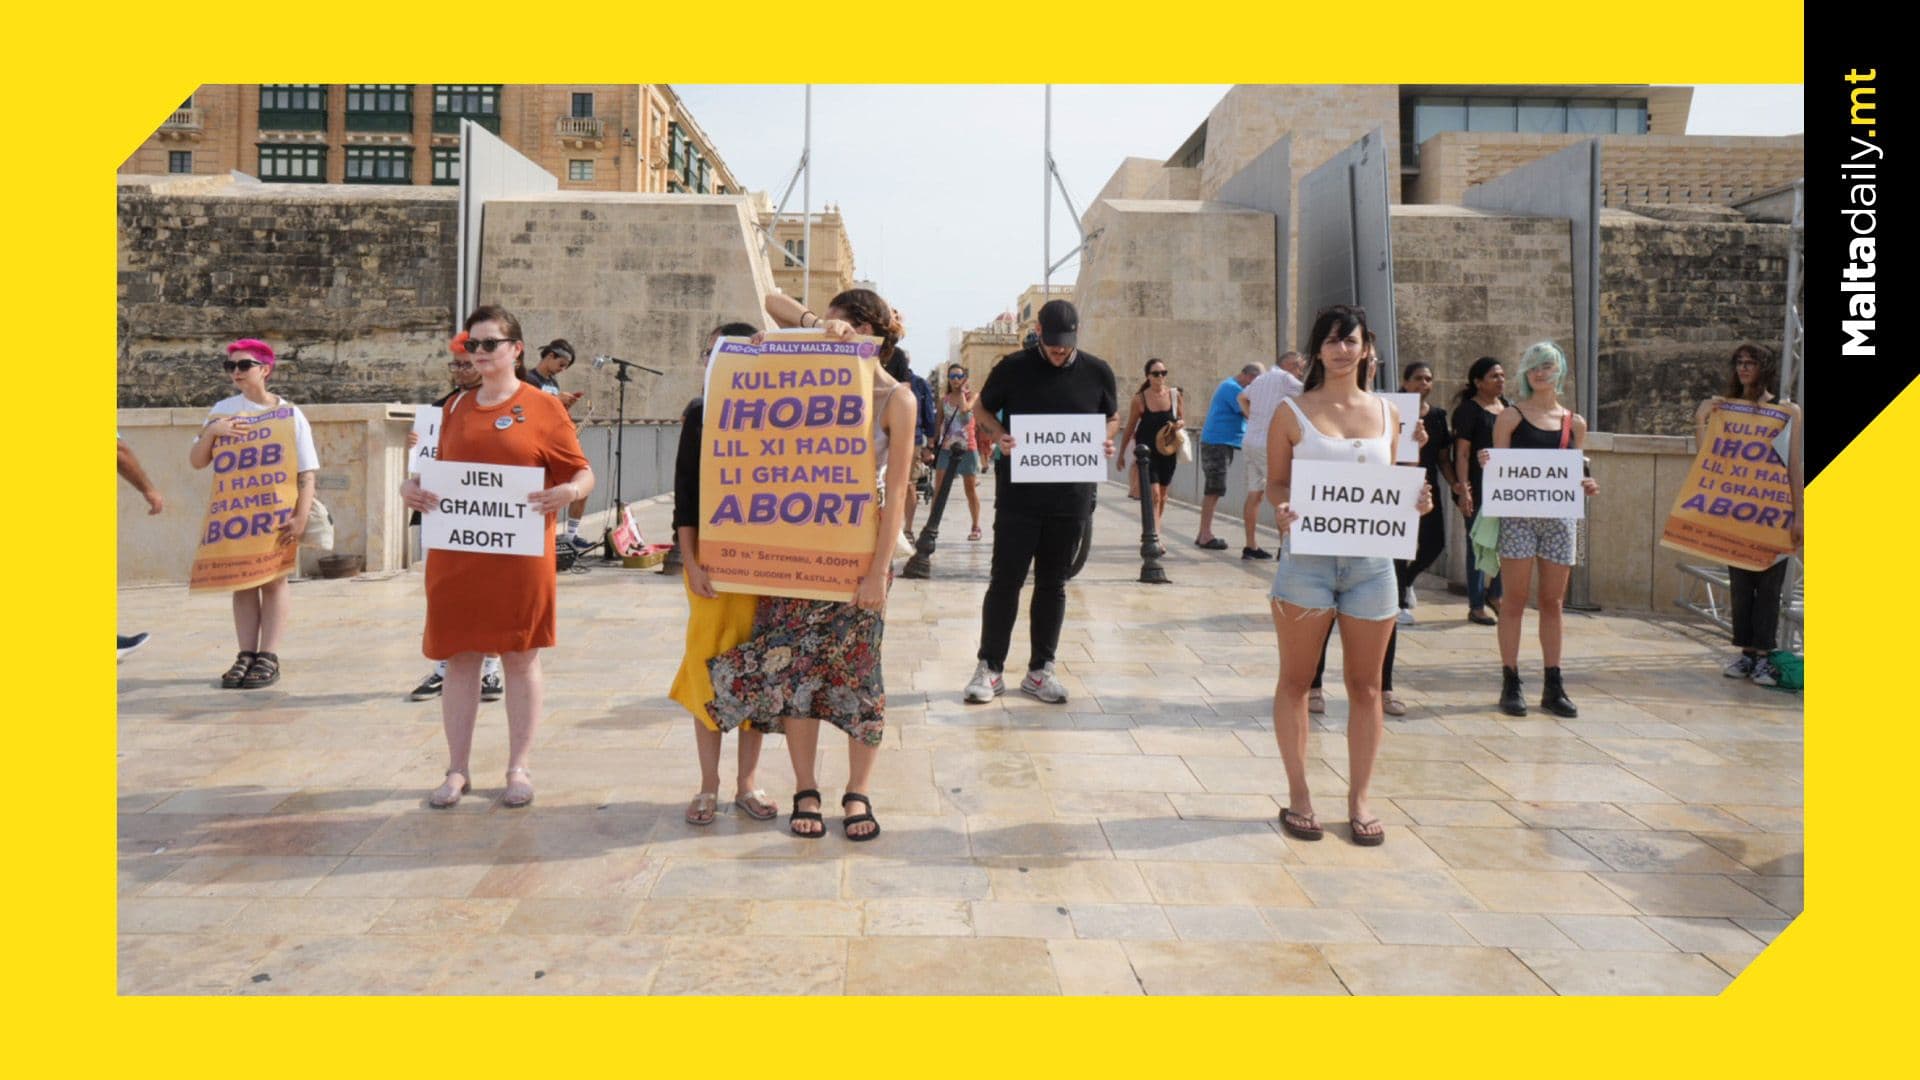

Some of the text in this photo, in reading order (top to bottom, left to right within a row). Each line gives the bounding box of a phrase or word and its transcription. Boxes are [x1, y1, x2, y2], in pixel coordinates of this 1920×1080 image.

[769, 344, 799, 353] RALLY
[801, 344, 832, 353] MALTA
[834, 345, 855, 353] 2023
[429, 424, 434, 435] I
[1025, 432, 1091, 443] I HAD AN
[713, 439, 749, 457] LIL
[760, 438, 785, 456] XI
[213, 443, 283, 474] OBB
[1020, 454, 1098, 466] ABORTION
[720, 468, 741, 485] LI
[1499, 466, 1568, 478] I HAD AN
[1702, 458, 1724, 476] LIL
[1730, 464, 1748, 478] XI
[461, 471, 503, 487] JIEN
[1698, 476, 1714, 490] LI
[1311, 485, 1401, 505] I HAD AN
[1491, 489, 1575, 502] ABORTION
[709, 492, 872, 526] ABORT
[1681, 493, 1795, 530] ABORT
[201, 507, 293, 545] BORT
[1300, 516, 1407, 537] ABORTION
[448, 529, 516, 548] ABORT
[721, 548, 736, 558] 30
